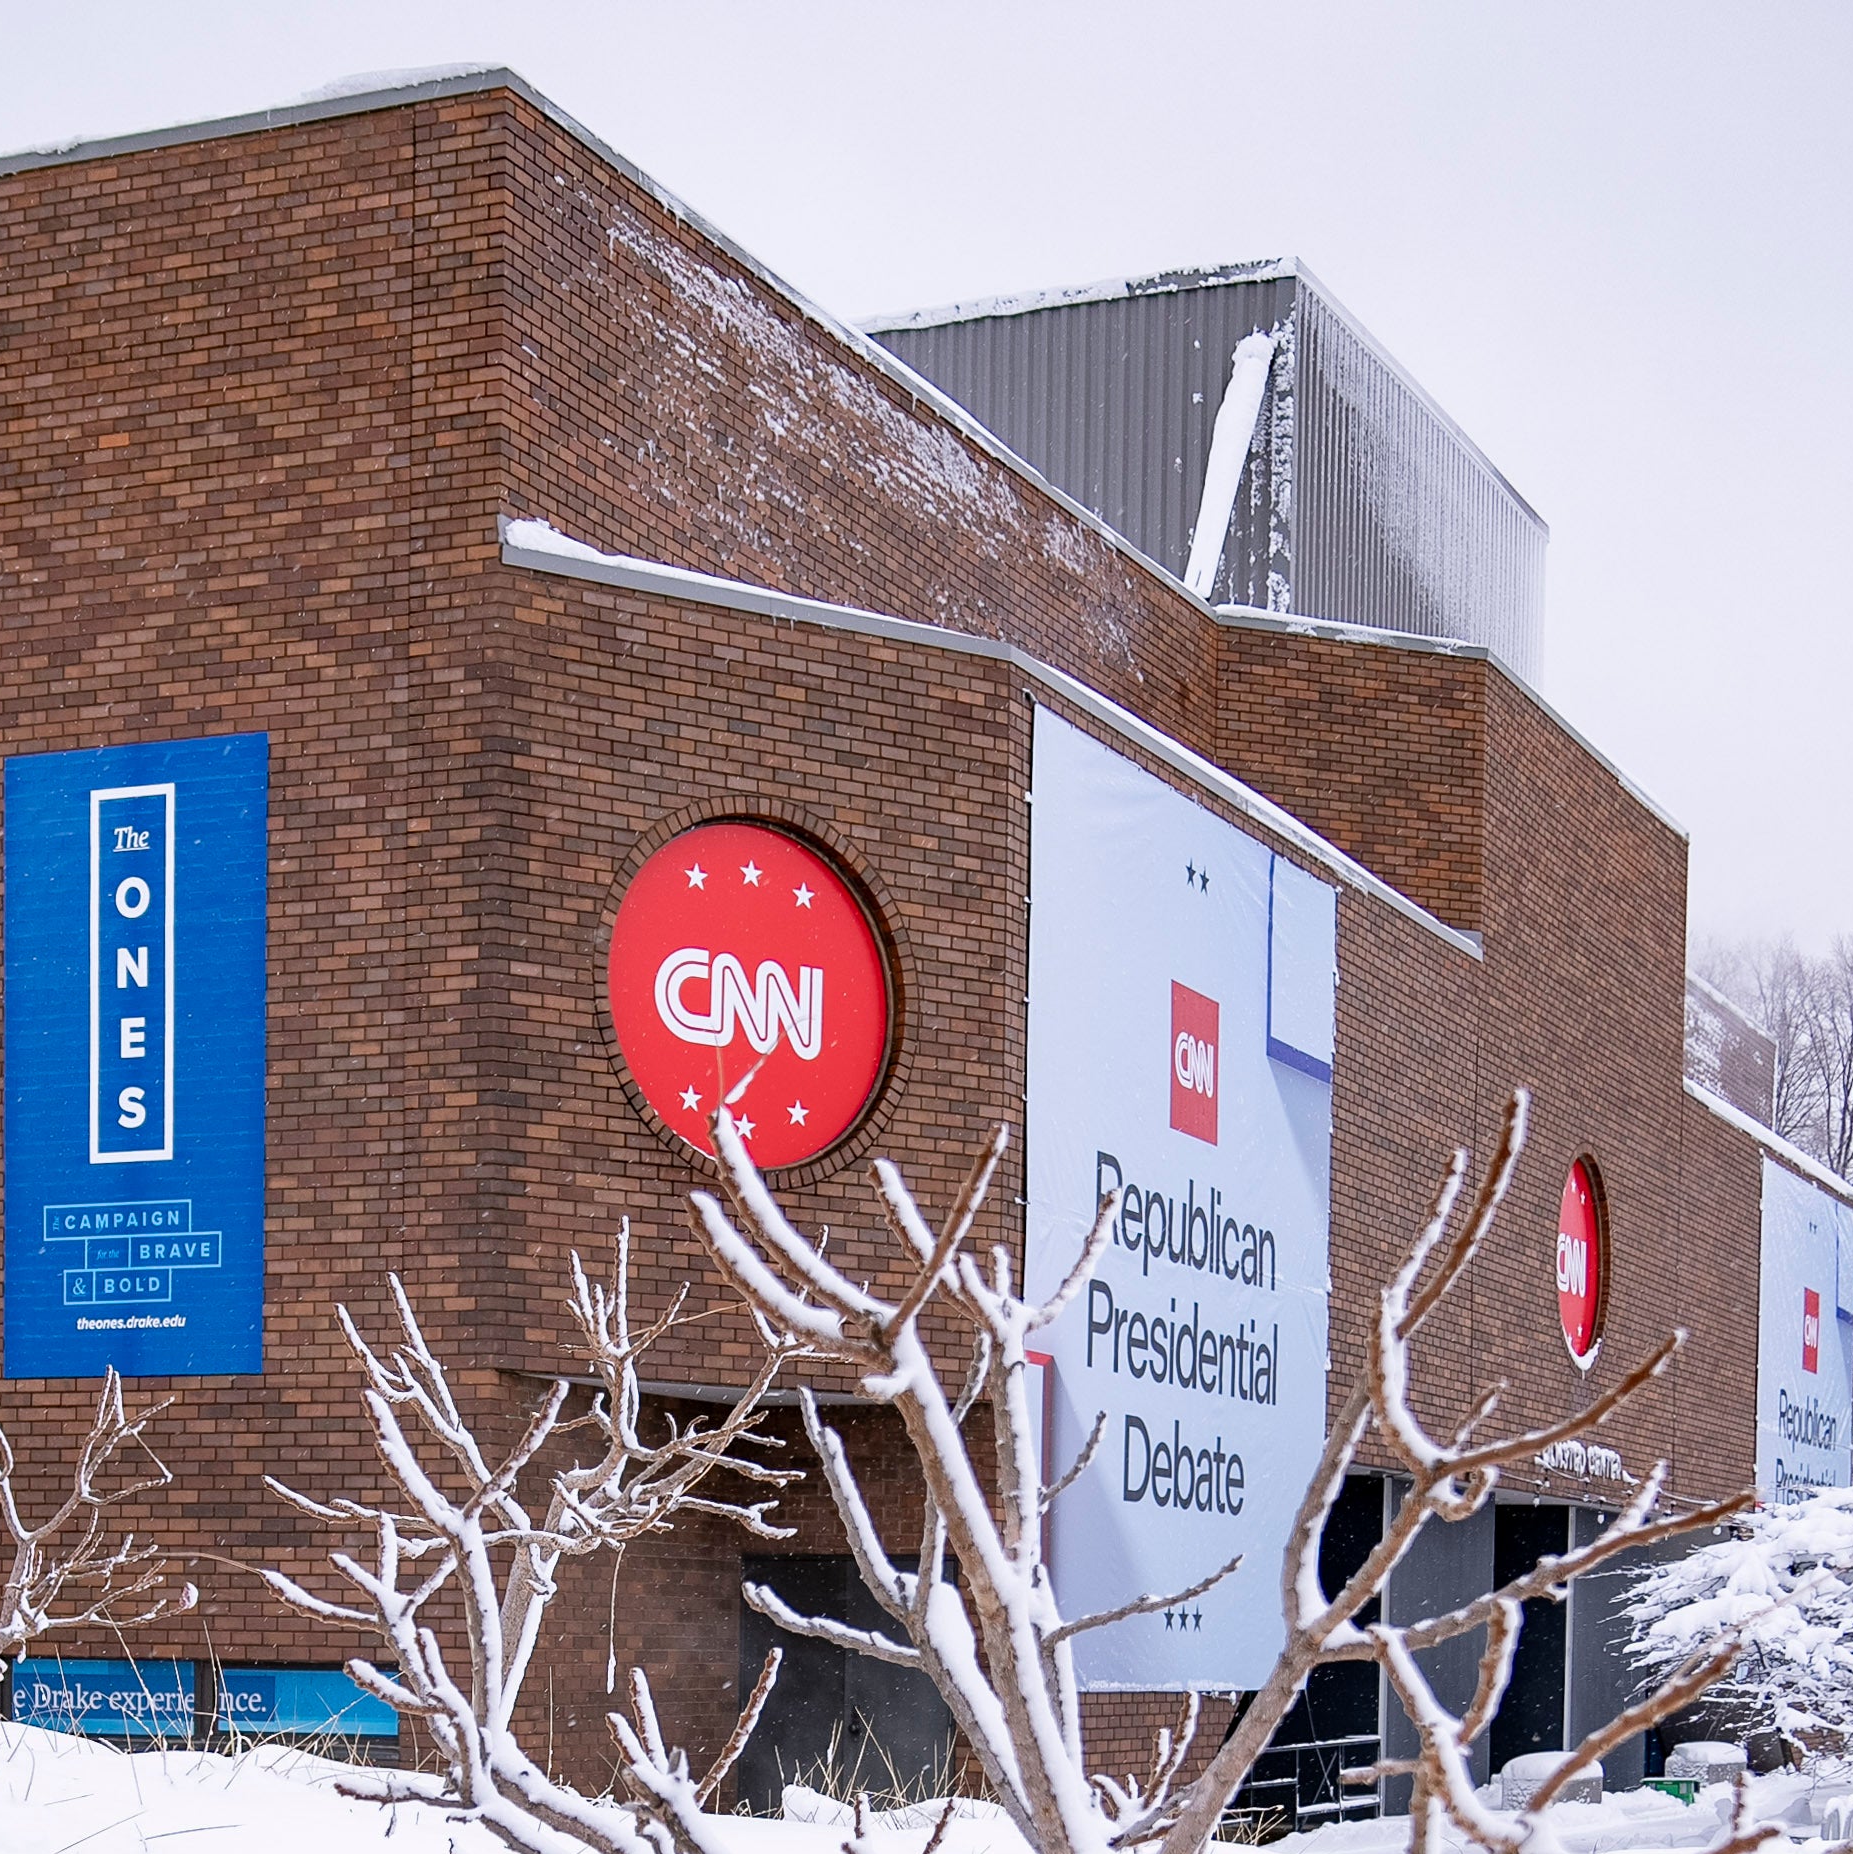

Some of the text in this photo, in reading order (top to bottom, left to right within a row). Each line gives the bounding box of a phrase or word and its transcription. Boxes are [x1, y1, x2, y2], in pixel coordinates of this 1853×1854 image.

[113, 826, 150, 850] The
[114, 876, 151, 1129] ONES
[653, 946, 824, 1061] CNN
[1175, 1030, 1216, 1101] CNN
[64, 1210, 179, 1230] CAMPAIGN
[139, 1242, 211, 1260] BRAVE
[1097, 1150, 1276, 1291] Republican
[72, 1276, 161, 1296] & BOLD
[1556, 1232, 1587, 1298] CNN
[76, 1313, 187, 1331] theones.drake.edu
[1087, 1279, 1278, 1406] Presidential
[1778, 1388, 1837, 1453] Republican
[1122, 1413, 1245, 1517] Debate
[32, 1682, 103, 1710] Drake
